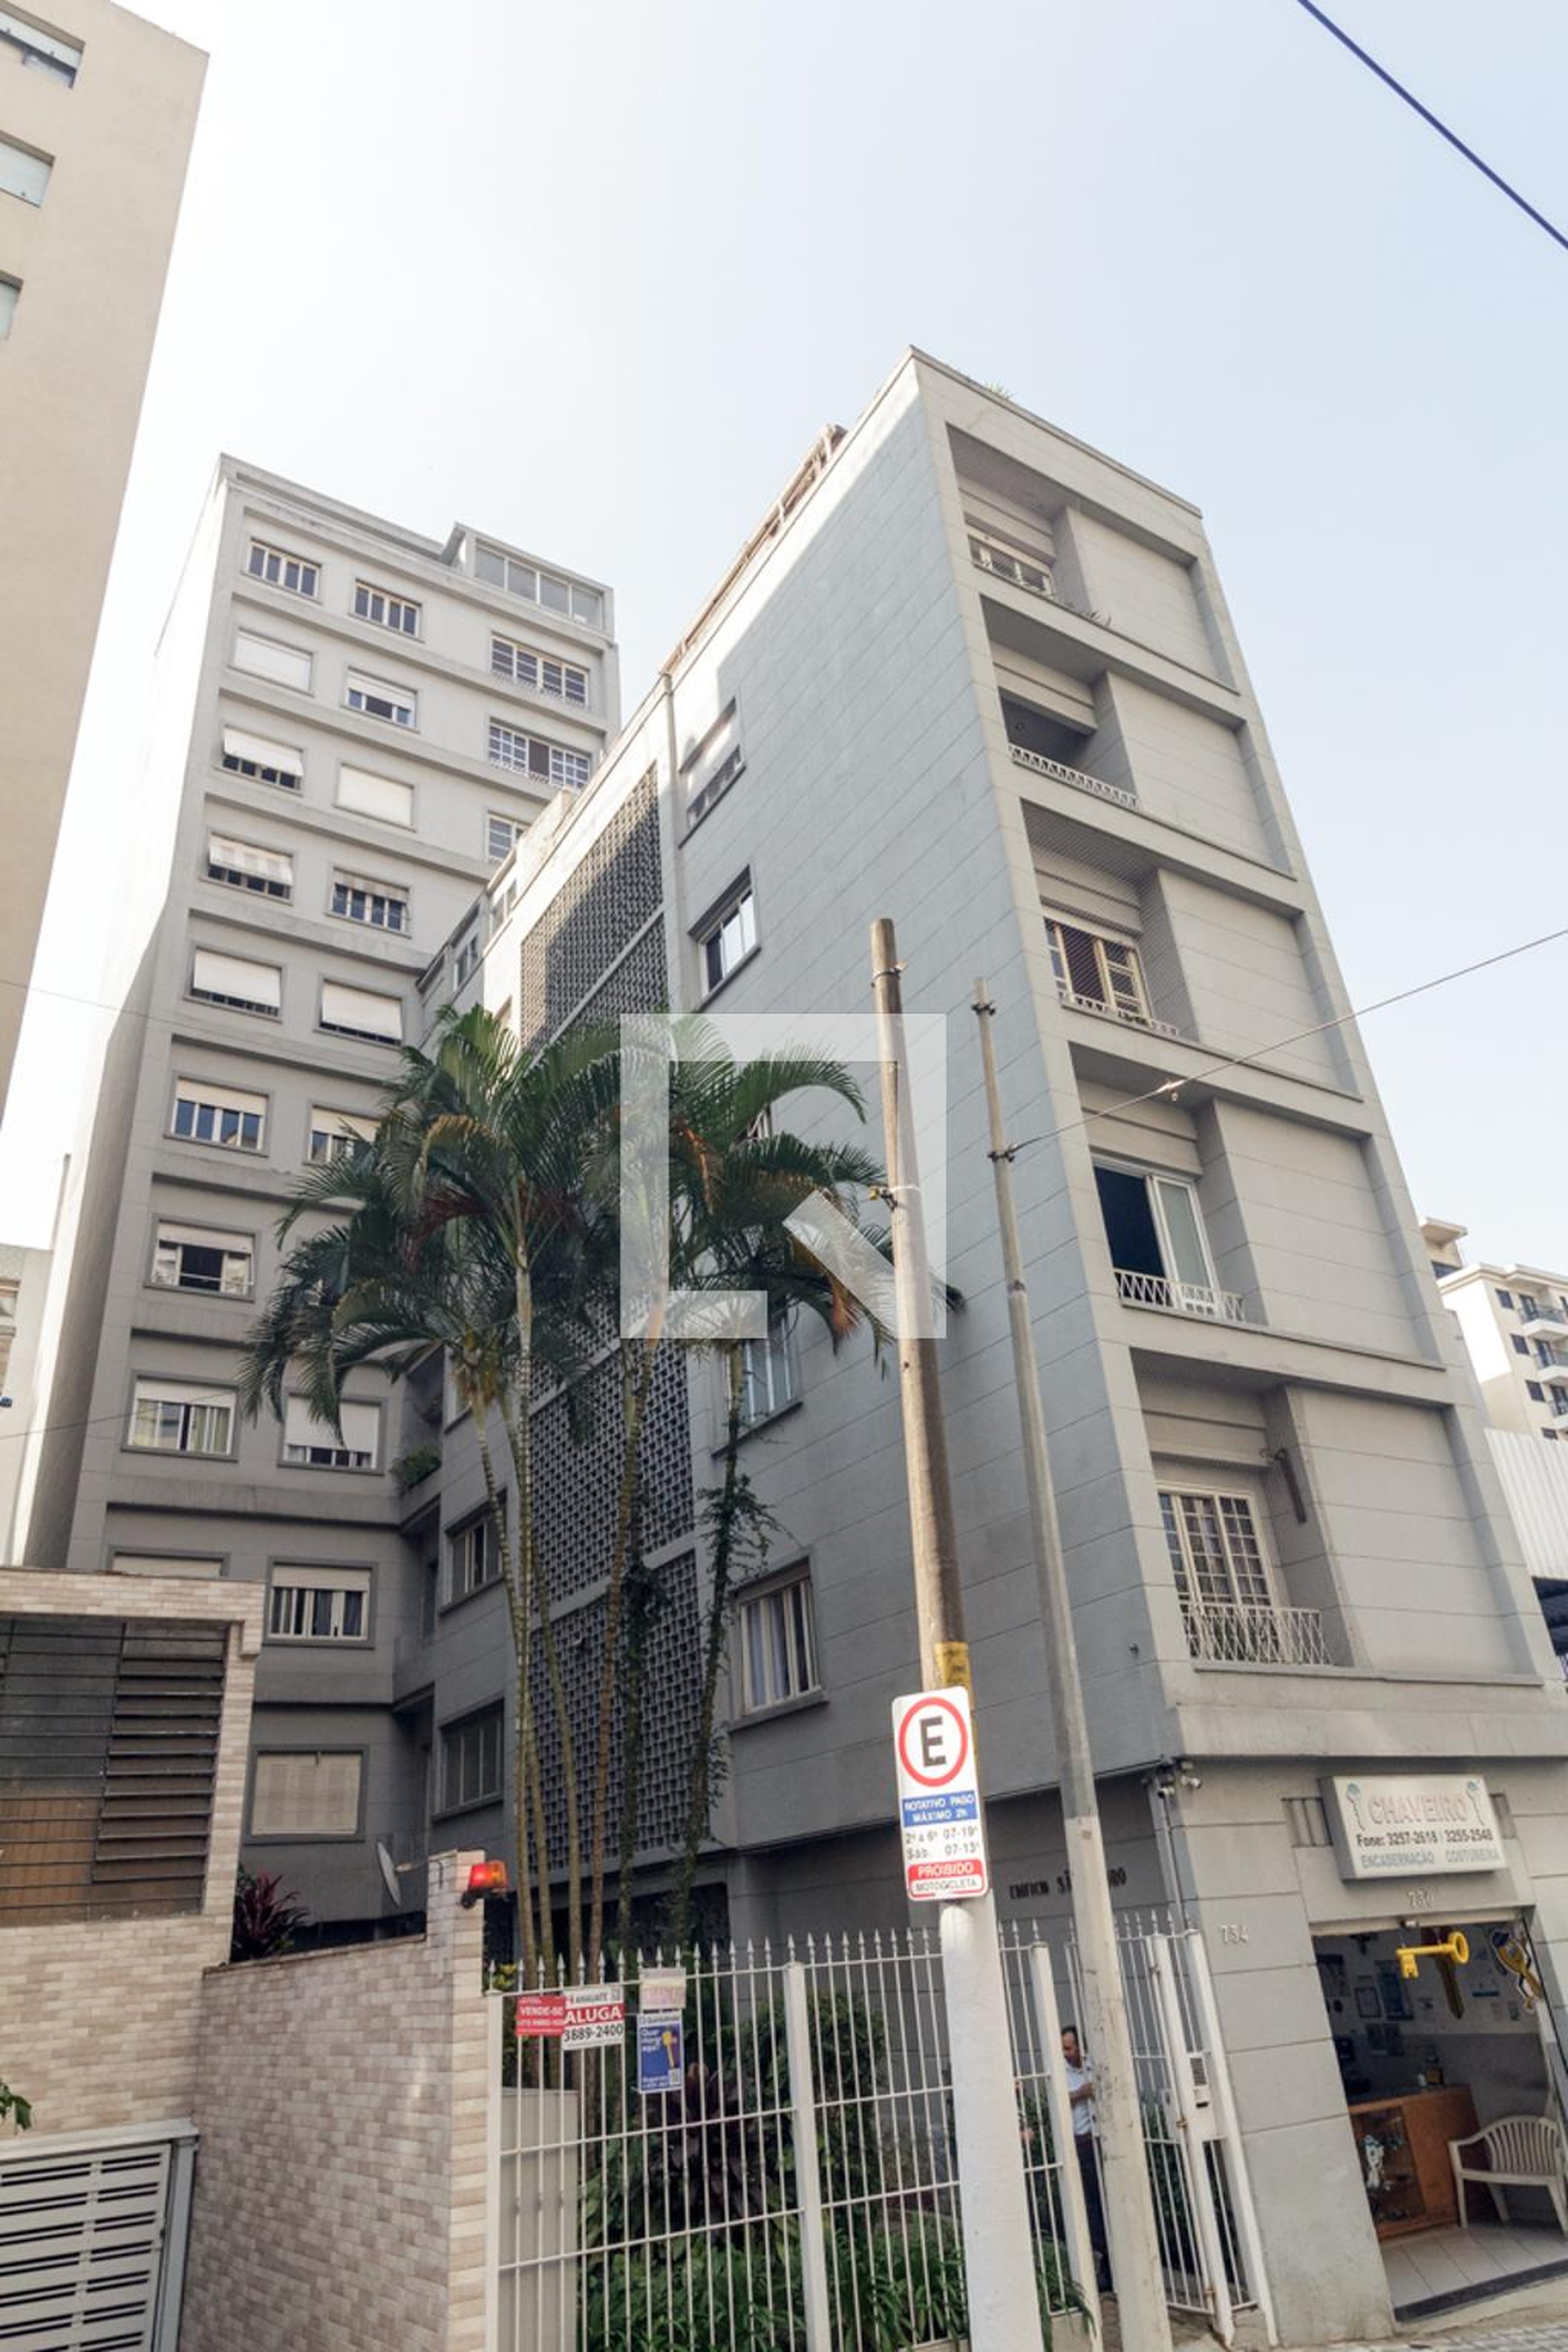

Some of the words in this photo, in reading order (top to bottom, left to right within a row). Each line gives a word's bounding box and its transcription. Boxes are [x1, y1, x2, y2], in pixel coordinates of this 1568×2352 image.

[920, 1715, 946, 1767] E
[1368, 1794, 1470, 1824] CHAVEIRO
[1356, 1834, 1384, 1847] Fone:
[918, 1862, 973, 1878] PROIBIDO
[565, 2007, 622, 2023] ALUGA
